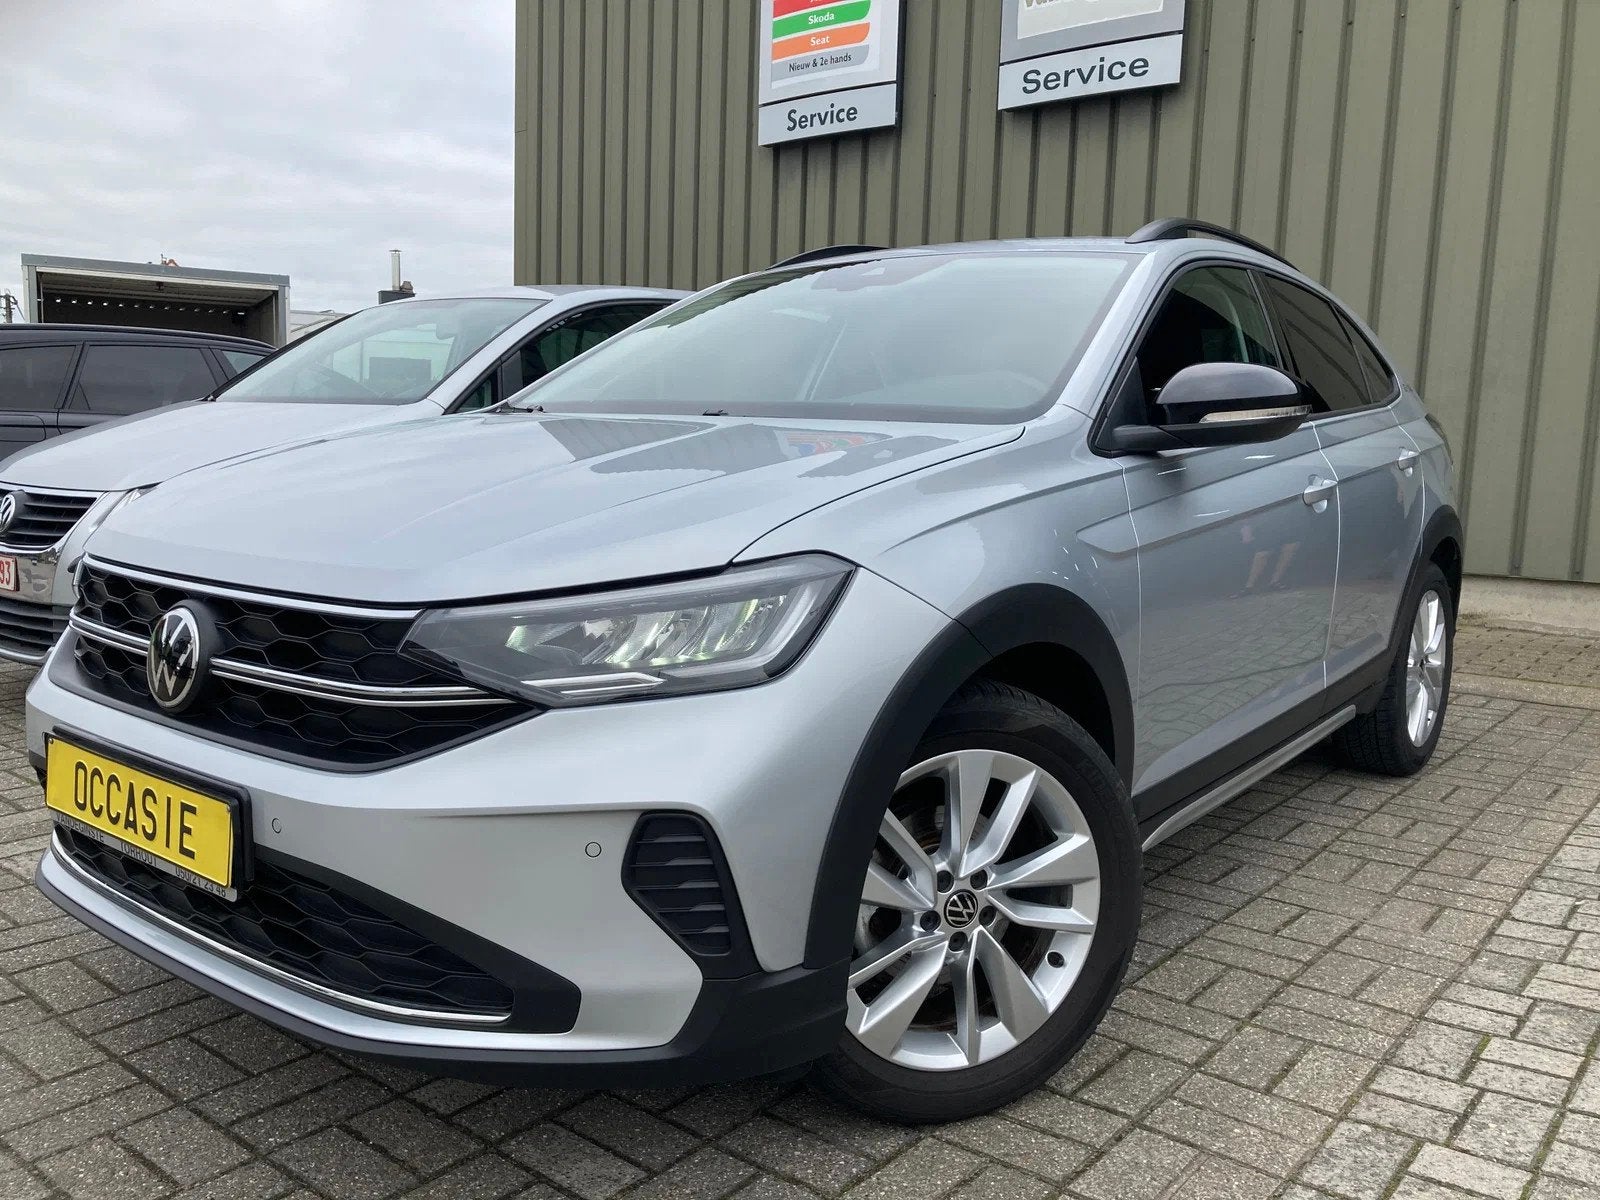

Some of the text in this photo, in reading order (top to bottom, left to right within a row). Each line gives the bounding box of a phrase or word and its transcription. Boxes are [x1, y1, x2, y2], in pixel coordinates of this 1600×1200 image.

[808, 12, 834, 24] Skoda
[810, 35, 830, 46] Seat
[789, 53, 852, 72] Nieuw & 2e hands
[1022, 57, 1149, 94] Service
[787, 103, 858, 131] Service
[74, 760, 197, 860] OCCASIE
